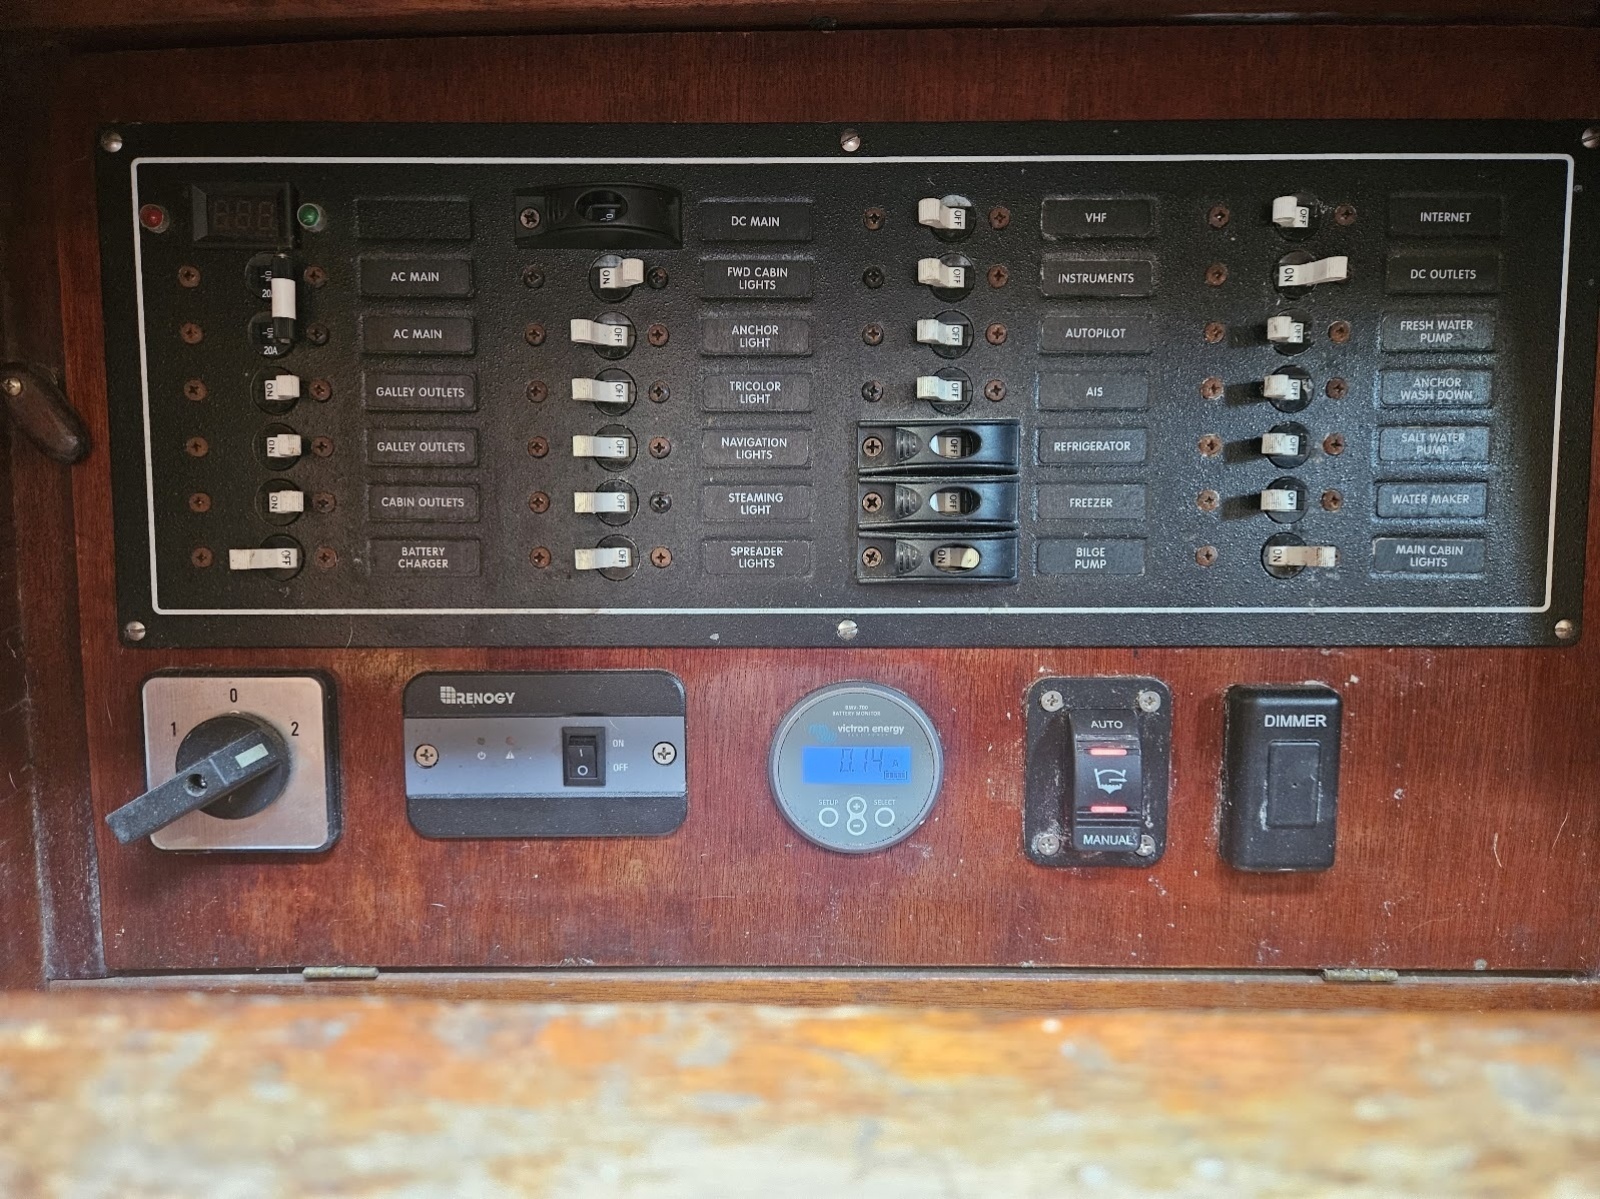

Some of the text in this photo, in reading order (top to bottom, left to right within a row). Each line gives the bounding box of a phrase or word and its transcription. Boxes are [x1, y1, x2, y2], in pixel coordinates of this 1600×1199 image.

[732, 216, 780, 226] DC MAIN
[954, 210, 962, 227] OFF
[1085, 213, 1107, 222] VHF
[1299, 208, 1308, 226] OFF
[1420, 212, 1471, 222] INTERNET
[390, 272, 439, 282] AC MAIN
[602, 269, 611, 284] ON
[728, 267, 787, 277] FWD CABIN
[952, 268, 961, 284] OFF
[1284, 268, 1295, 282] ON
[1411, 269, 1476, 279] DC OUTLETS
[1058, 273, 1134, 283] INSTRUMENTS
[739, 280, 776, 289] LIGHTS
[732, 325, 778, 334] ANCHOR
[1400, 320, 1473, 330] FRESH WATER
[393, 329, 442, 339] AC MAIN
[614, 328, 623, 343] OFF
[951, 326, 960, 342] OFF
[1065, 328, 1126, 338] AUTOPILOT
[1420, 333, 1453, 342] PUMP
[740, 338, 770, 347] LIGHT
[264, 346, 278, 355] 20A
[730, 381, 781, 391] TRICOLOR
[1413, 378, 1461, 387] ANCHOR
[265, 382, 274, 397] ON
[376, 387, 465, 398] GALLEY OUTLETS
[951, 383, 959, 398] OFF
[1086, 387, 1103, 396] AIS
[740, 394, 770, 403] LIGHT
[1400, 390, 1473, 400] WASH DOWN
[722, 437, 787, 447] NAVIGATION
[1401, 433, 1465, 443] SALT WATER
[268, 439, 275, 454] ON
[377, 442, 465, 452] GALLEY OUTLETS
[615, 440, 625, 454] OFF
[950, 439, 958, 455] OFF
[1054, 441, 1130, 451] REFRIGERATOR
[1416, 446, 1449, 455] PUMP
[736, 450, 772, 460] LIGHTS
[270, 495, 278, 510] ON
[381, 497, 464, 507] CABIN OUTLETS
[616, 494, 626, 510] OFF
[728, 493, 783, 502] STEAMING
[949, 494, 957, 510] OFF
[1070, 498, 1113, 507] FREEZER
[1392, 494, 1469, 504] WATER MAKER
[741, 505, 771, 515] LIGHT
[402, 547, 445, 556] BATTERY
[730, 547, 783, 556] SPREADER
[1076, 548, 1105, 557] BILGE
[1396, 545, 1463, 555] MAIN CABIN
[281, 550, 291, 565] OFF
[937, 550, 946, 564] ON
[1272, 549, 1283, 563] ON
[398, 559, 448, 568] CHARGER
[739, 559, 775, 568] LIGHTS
[1075, 560, 1106, 569] PUMP
[1410, 558, 1447, 567] LIGHTS
[230, 688, 237, 703] 0
[457, 692, 515, 704] RENOGY
[1091, 720, 1123, 729] AUTO
[1264, 715, 1327, 727] DIMMER
[170, 722, 177, 737] 1
[291, 721, 299, 736] 2
[838, 724, 869, 733] victron
[872, 725, 904, 735] energy
[613, 740, 624, 748] ON
[840, 749, 883, 772] 0.14
[613, 764, 628, 772] OFF
[1083, 835, 1133, 845] MANUAL
